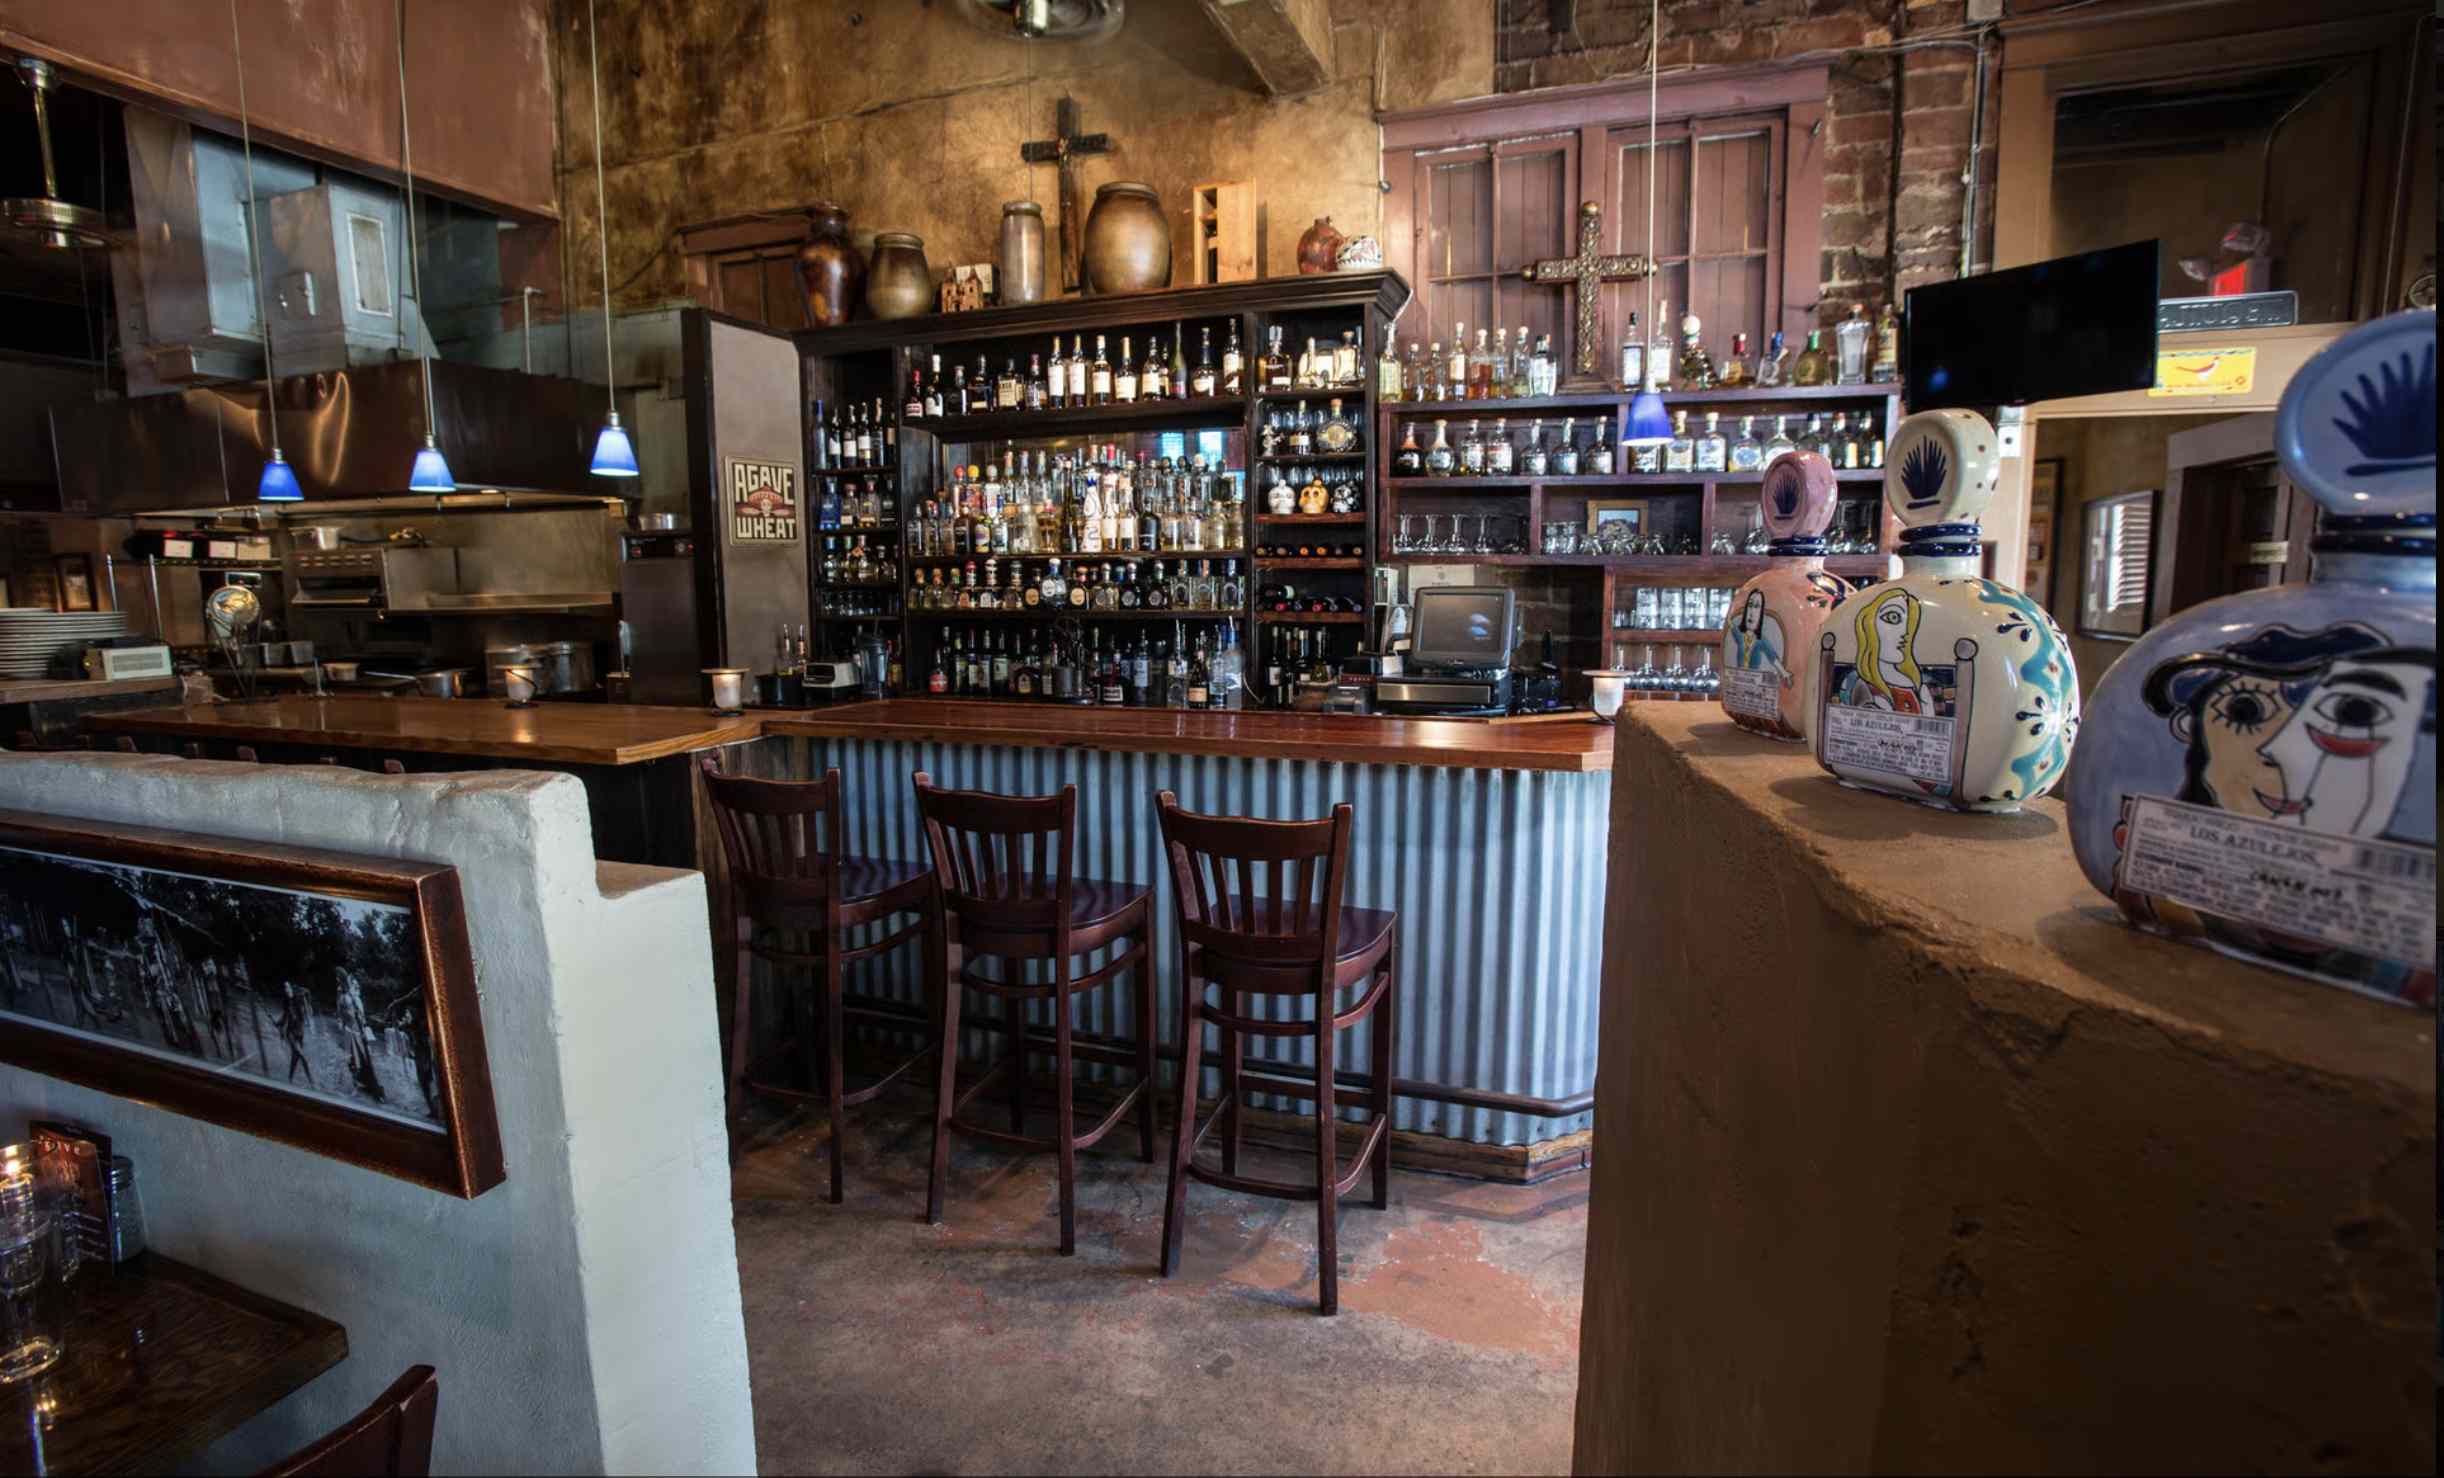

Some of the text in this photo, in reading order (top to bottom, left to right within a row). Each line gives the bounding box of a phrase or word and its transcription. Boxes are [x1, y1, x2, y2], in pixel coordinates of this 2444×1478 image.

[734, 464, 794, 505] AGAVE
[737, 517, 795, 539] WHEAT
[2191, 825, 2219, 842] LOS
